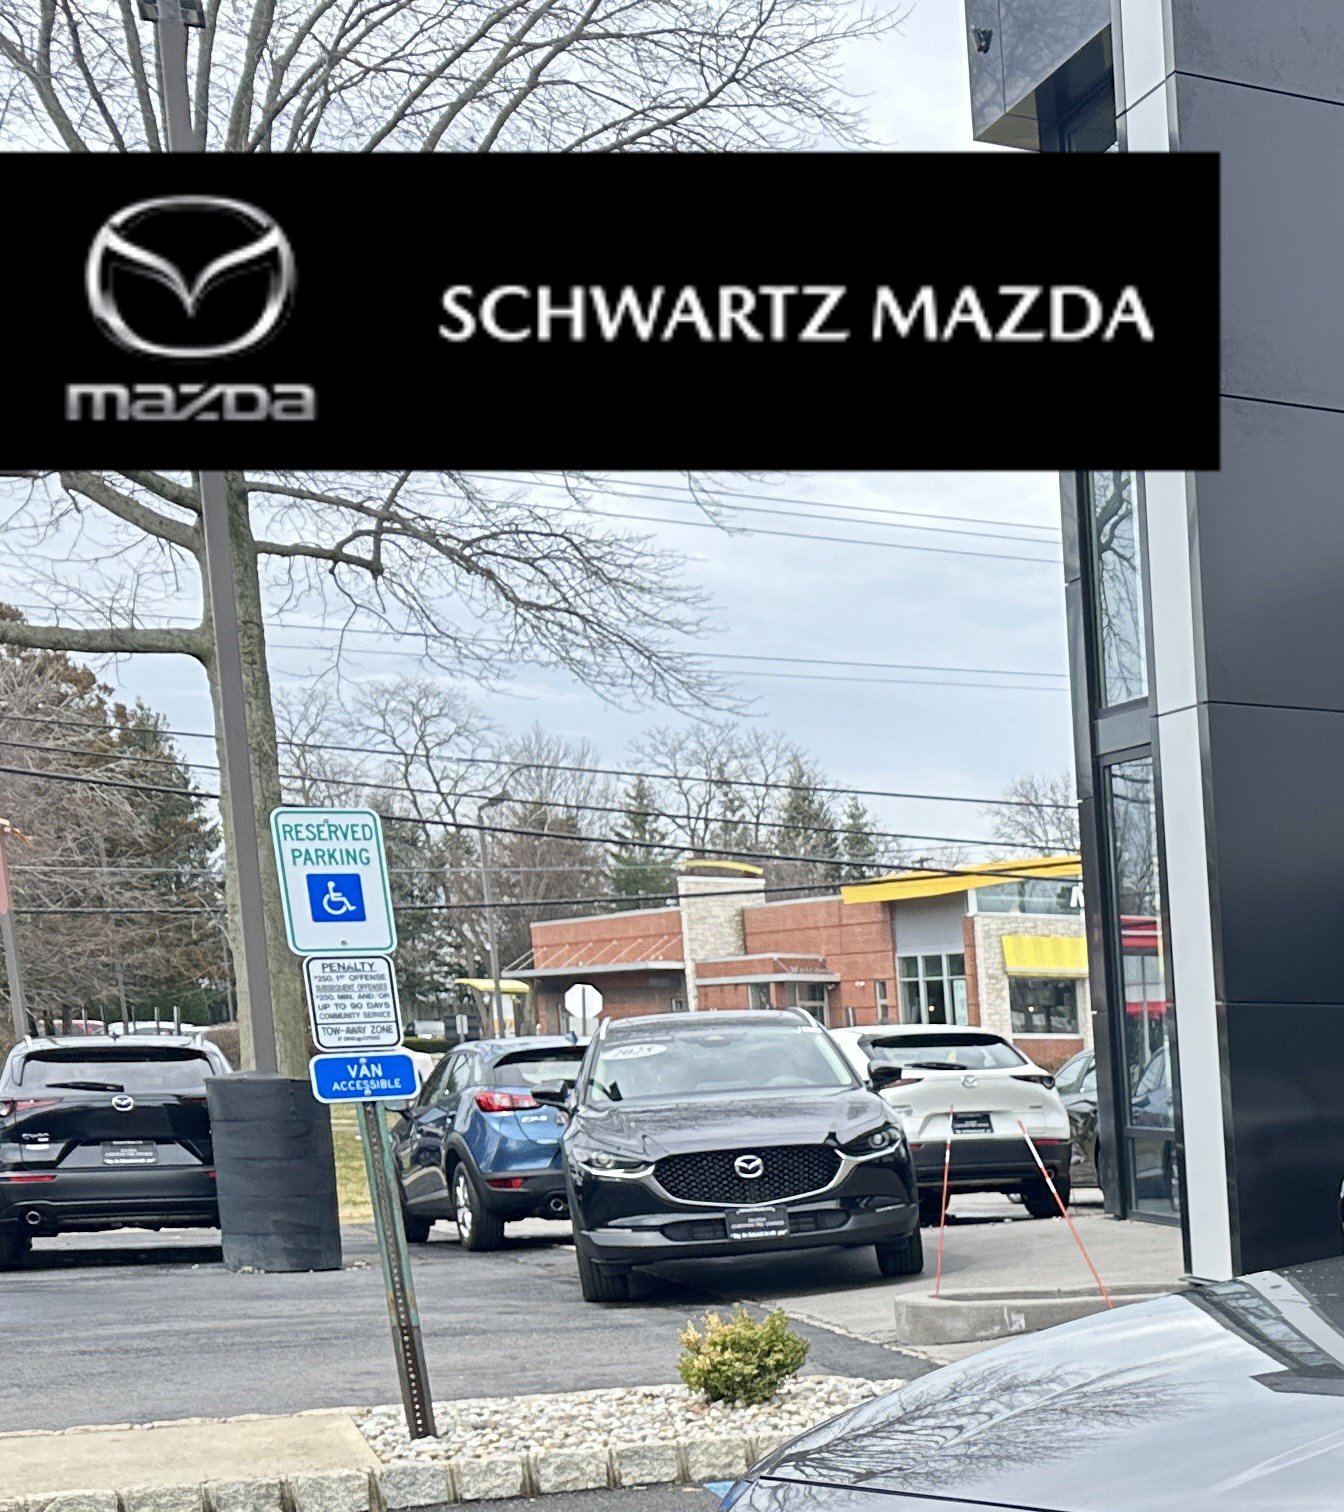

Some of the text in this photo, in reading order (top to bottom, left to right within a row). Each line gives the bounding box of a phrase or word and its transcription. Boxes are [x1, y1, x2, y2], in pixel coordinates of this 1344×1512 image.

[282, 822, 373, 842] RESERVED
[290, 847, 371, 867] PARKING
[321, 961, 375, 973] PENALTY
[348, 973, 386, 982] OFFENSE
[317, 1003, 331, 1011] UP
[333, 1002, 347, 1010] TO
[366, 1001, 391, 1010] DAYS
[362, 1011, 391, 1019] SERVICE
[321, 1024, 394, 1036] TOW-AWAY ZONE
[346, 1063, 383, 1079] VAN
[332, 1077, 402, 1093] ACCESSIBLE
